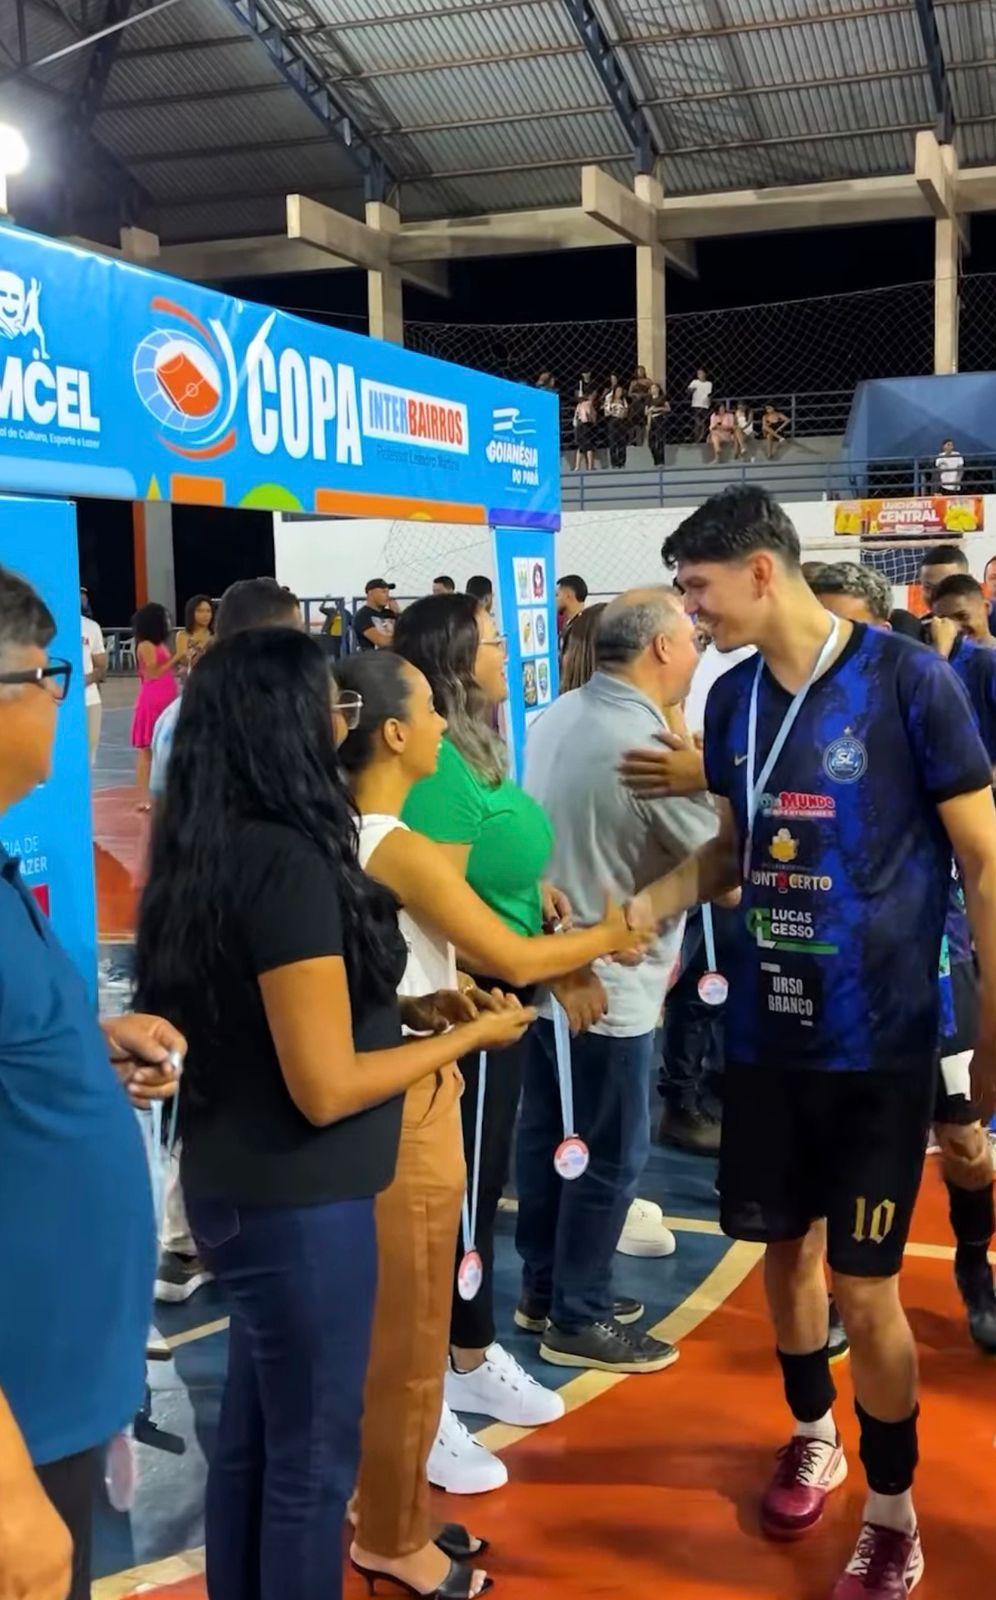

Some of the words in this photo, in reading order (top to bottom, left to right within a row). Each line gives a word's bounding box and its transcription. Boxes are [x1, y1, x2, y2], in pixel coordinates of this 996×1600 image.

[246, 338, 363, 466] COPA
[878, 509, 940, 524] CENTRAL
[780, 792, 836, 809] MUNDO
[24, 835, 39, 855] DE
[789, 873, 833, 891] CERTO
[772, 908, 812, 924] LUCAS
[771, 922, 814, 938] GESSO
[773, 976, 804, 996] URSO
[768, 994, 813, 1016] BRANCO
[852, 1196, 896, 1244] 10
